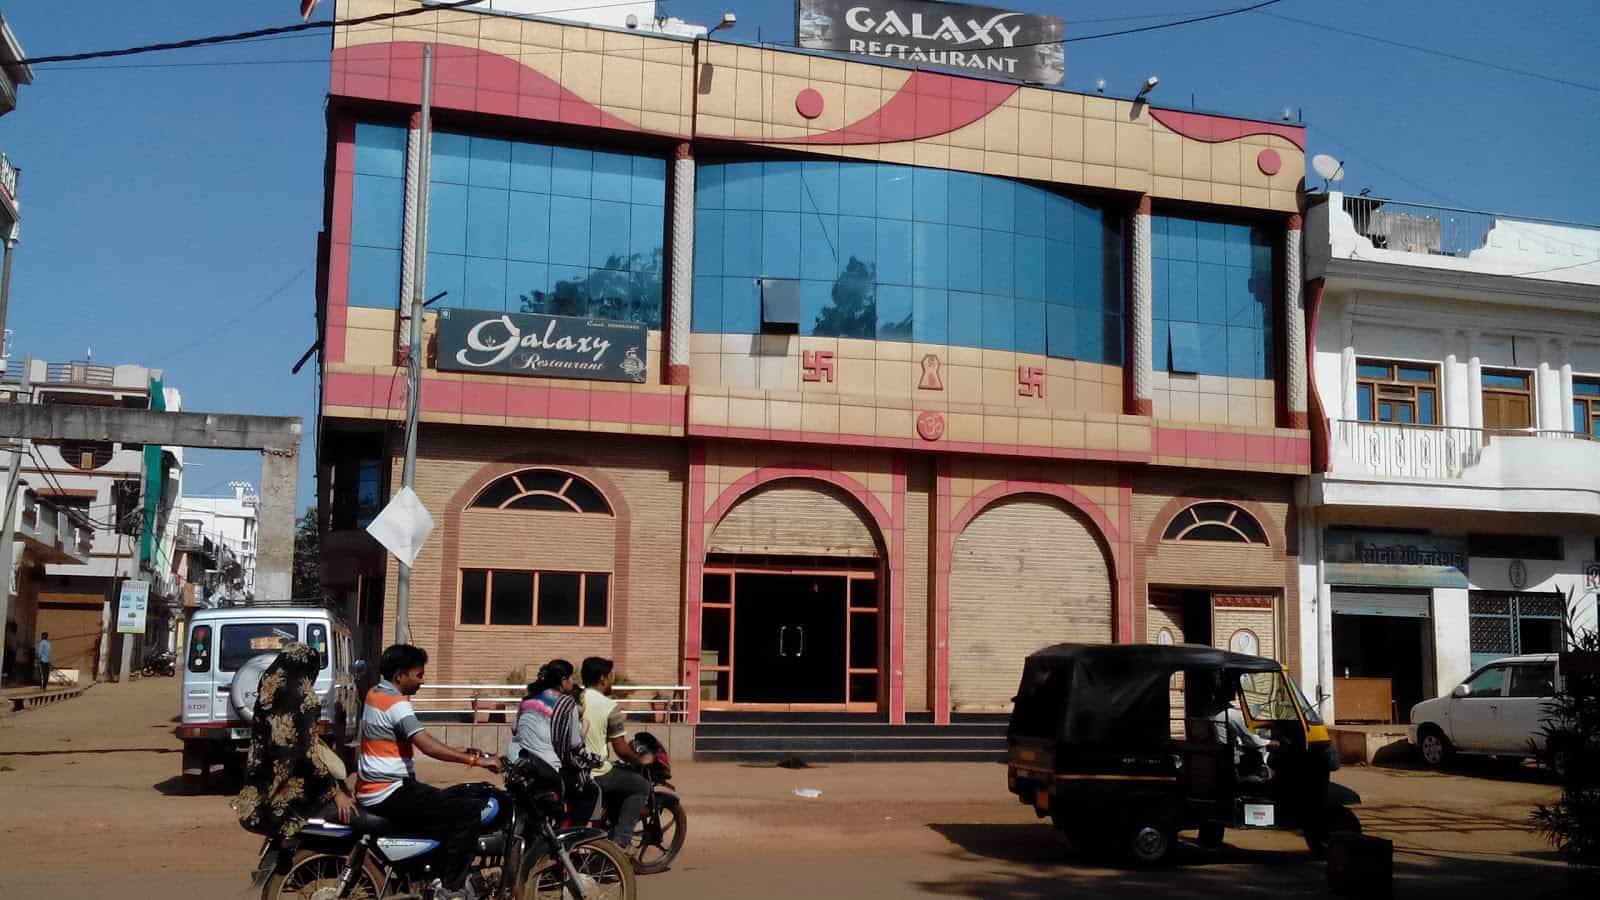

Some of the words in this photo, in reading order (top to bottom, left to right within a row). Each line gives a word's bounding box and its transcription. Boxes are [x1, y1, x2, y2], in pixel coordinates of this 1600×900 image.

[845, 7, 1024, 48] GALAXY
[849, 39, 1018, 74] RESTAURANT
[456, 315, 611, 368] Galaxy
[520, 353, 605, 371] Restaurant
